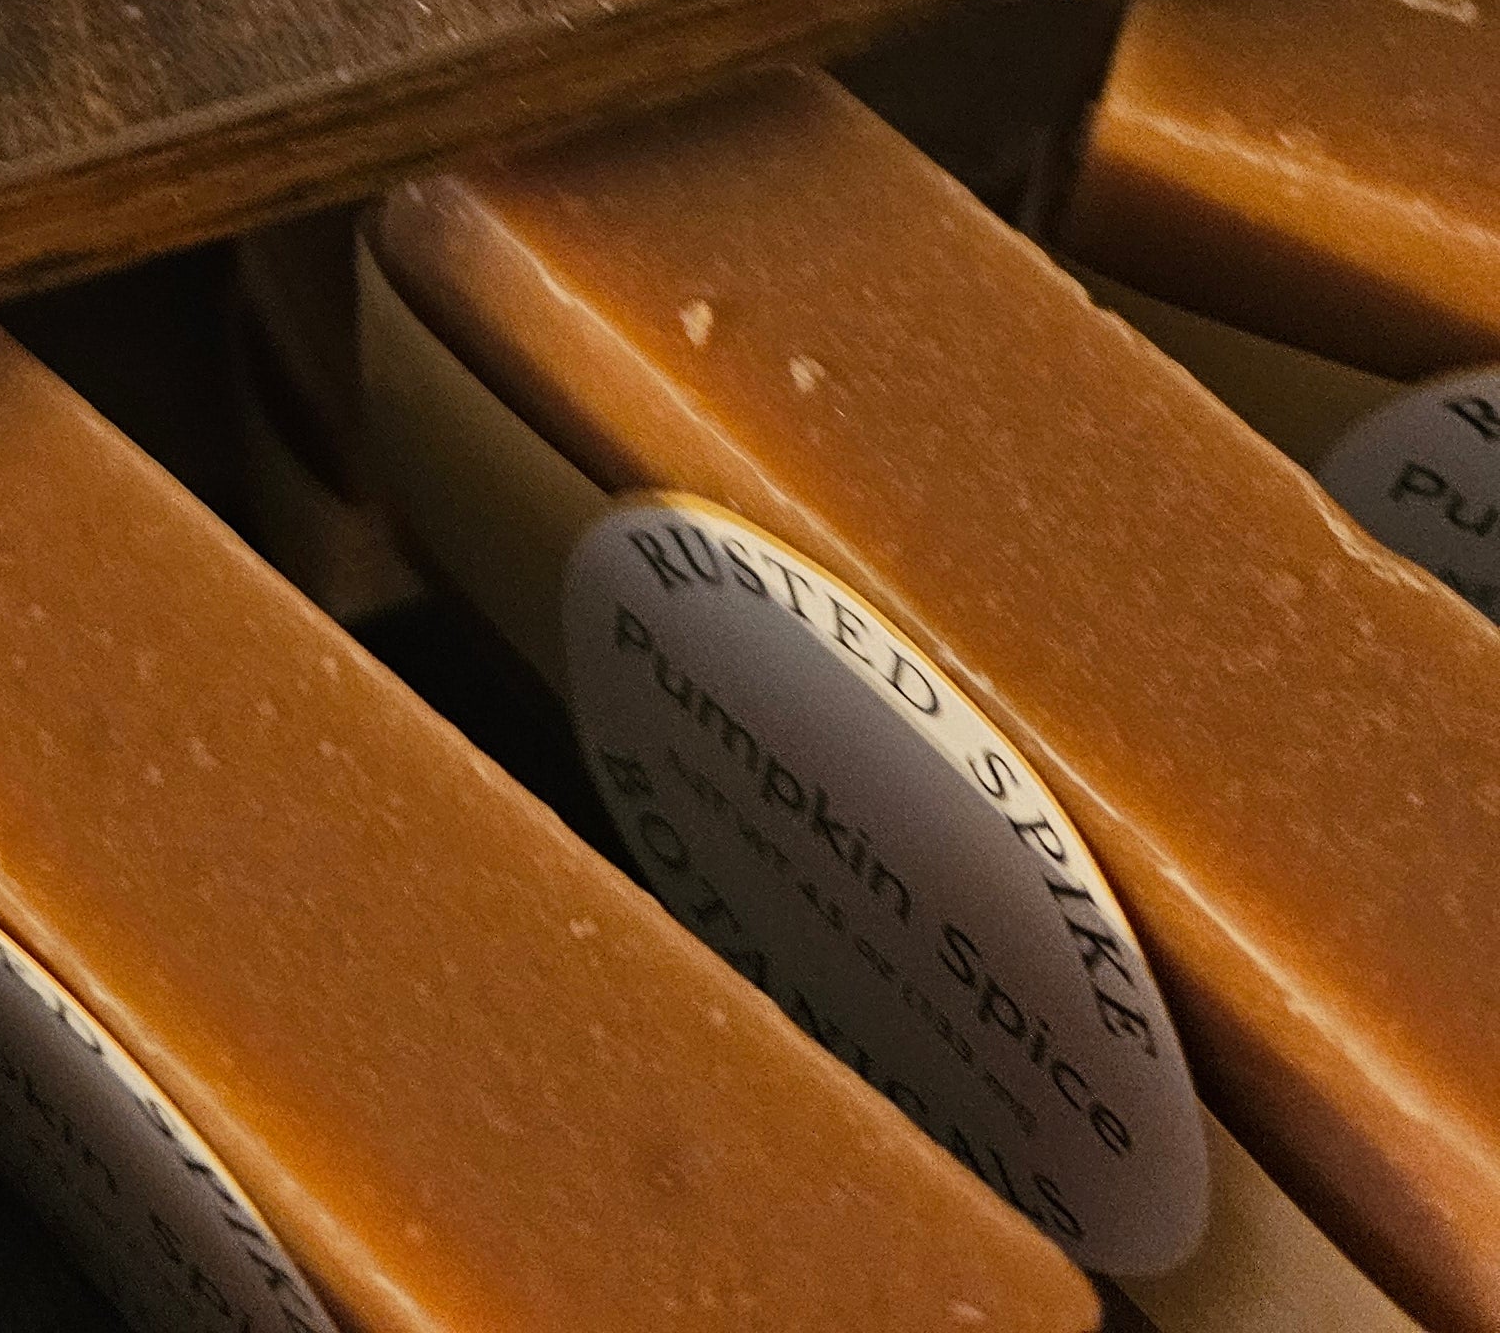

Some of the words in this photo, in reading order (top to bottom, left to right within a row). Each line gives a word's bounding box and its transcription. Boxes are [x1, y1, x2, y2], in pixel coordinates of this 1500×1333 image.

[614, 603, 913, 927] Pumpkin
[937, 921, 1135, 1161] Spice
[628, 523, 943, 719] RUSTED
[965, 747, 1159, 1063] SPIKE
